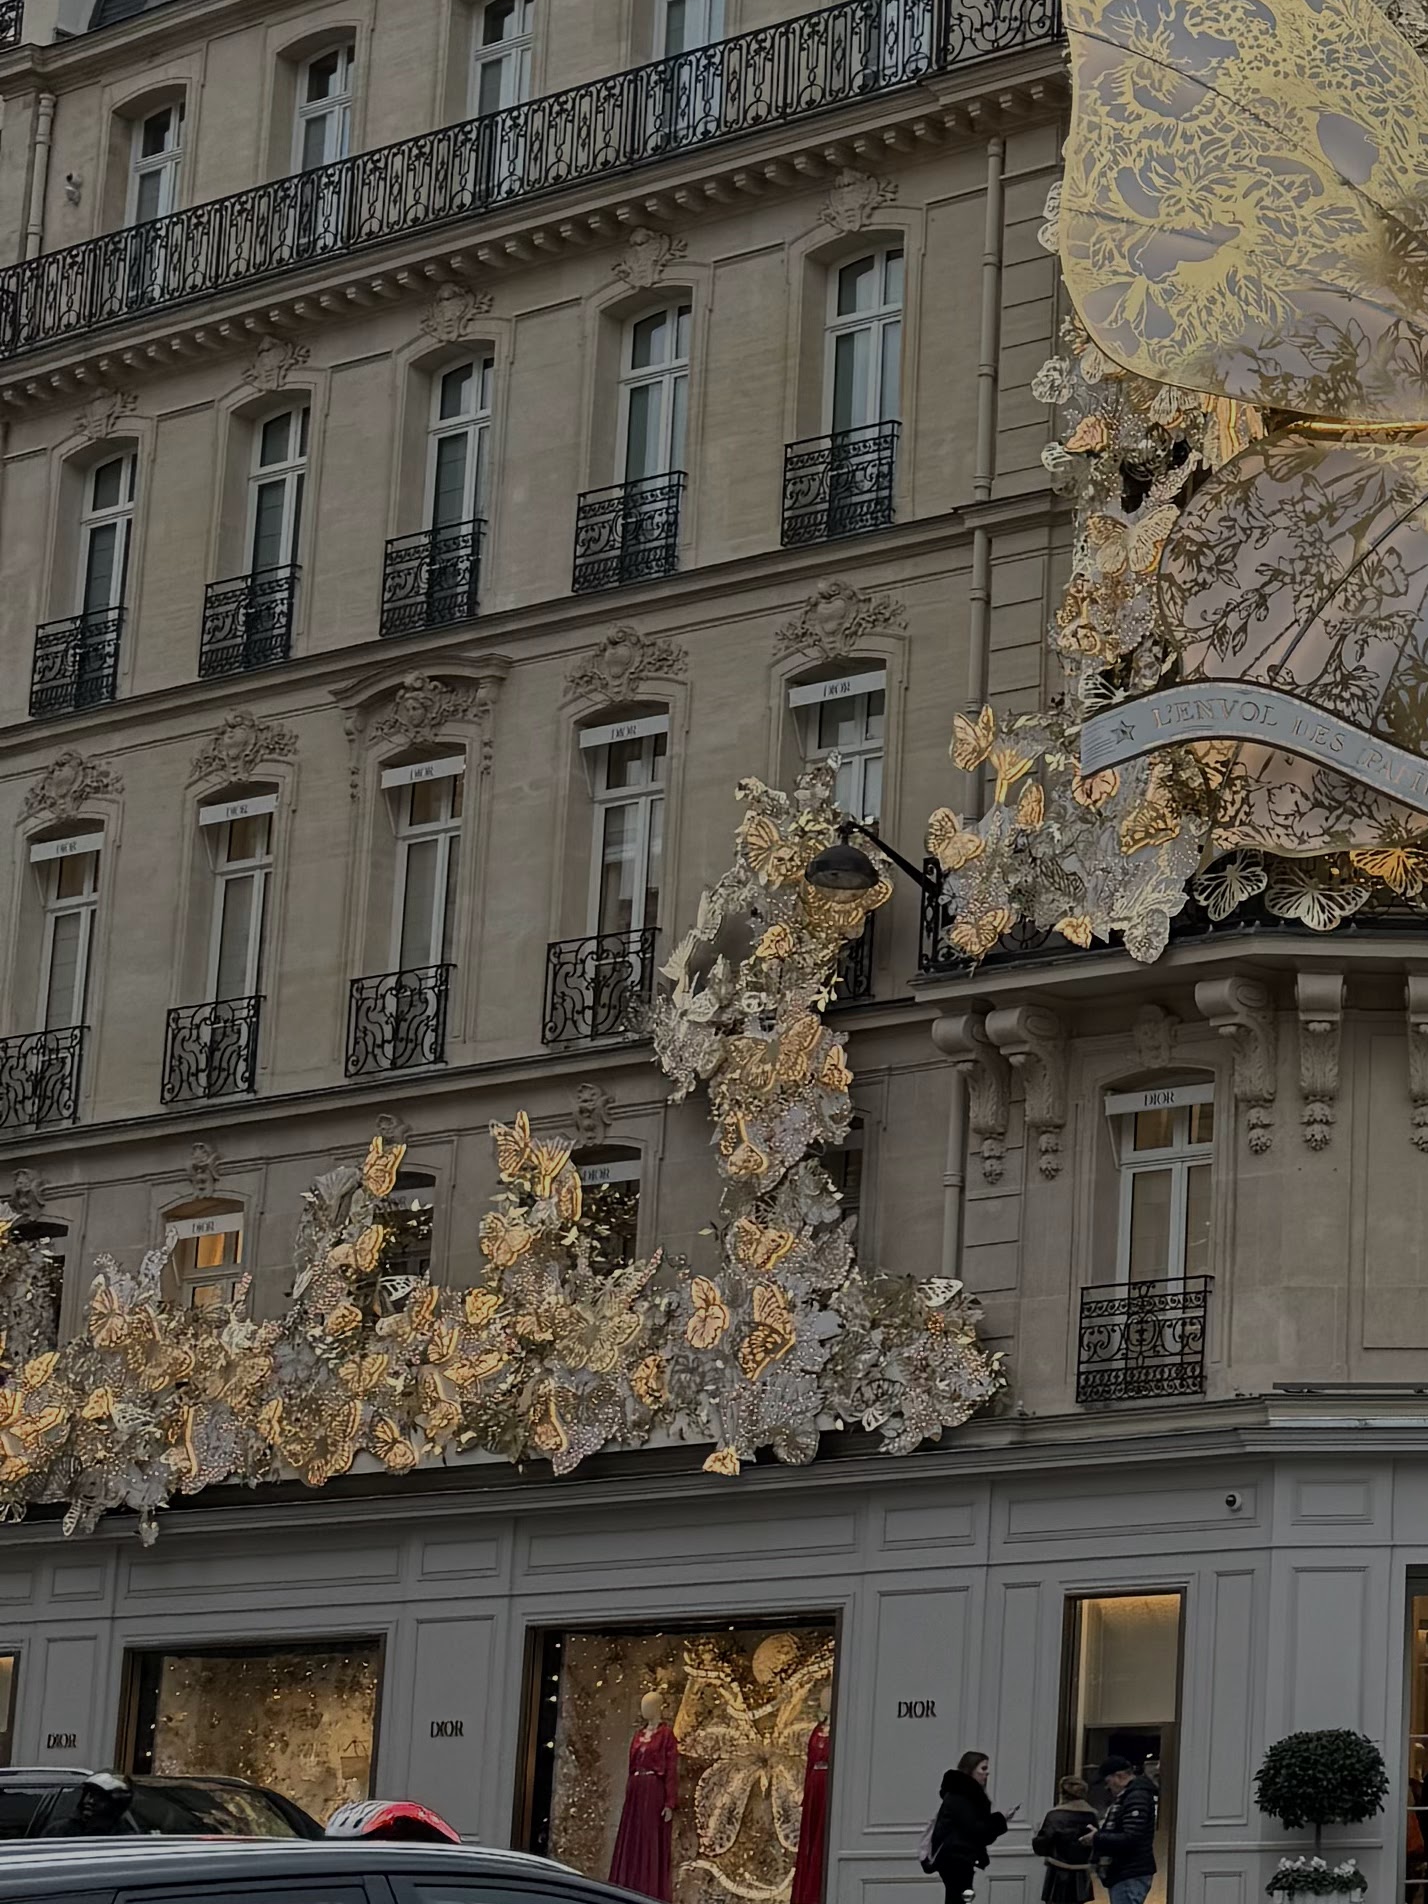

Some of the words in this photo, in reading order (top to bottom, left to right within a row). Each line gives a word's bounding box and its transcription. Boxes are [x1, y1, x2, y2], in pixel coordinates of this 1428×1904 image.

[1151, 697, 1278, 729] L'ENVOL
[1291, 718, 1345, 752] DES
[1144, 1090, 1175, 1107] DIOR
[583, 1167, 610, 1183] DIOR
[897, 1700, 937, 1719] DIOR
[430, 1720, 464, 1738] DIOR
[47, 1733, 77, 1749] DIOR
